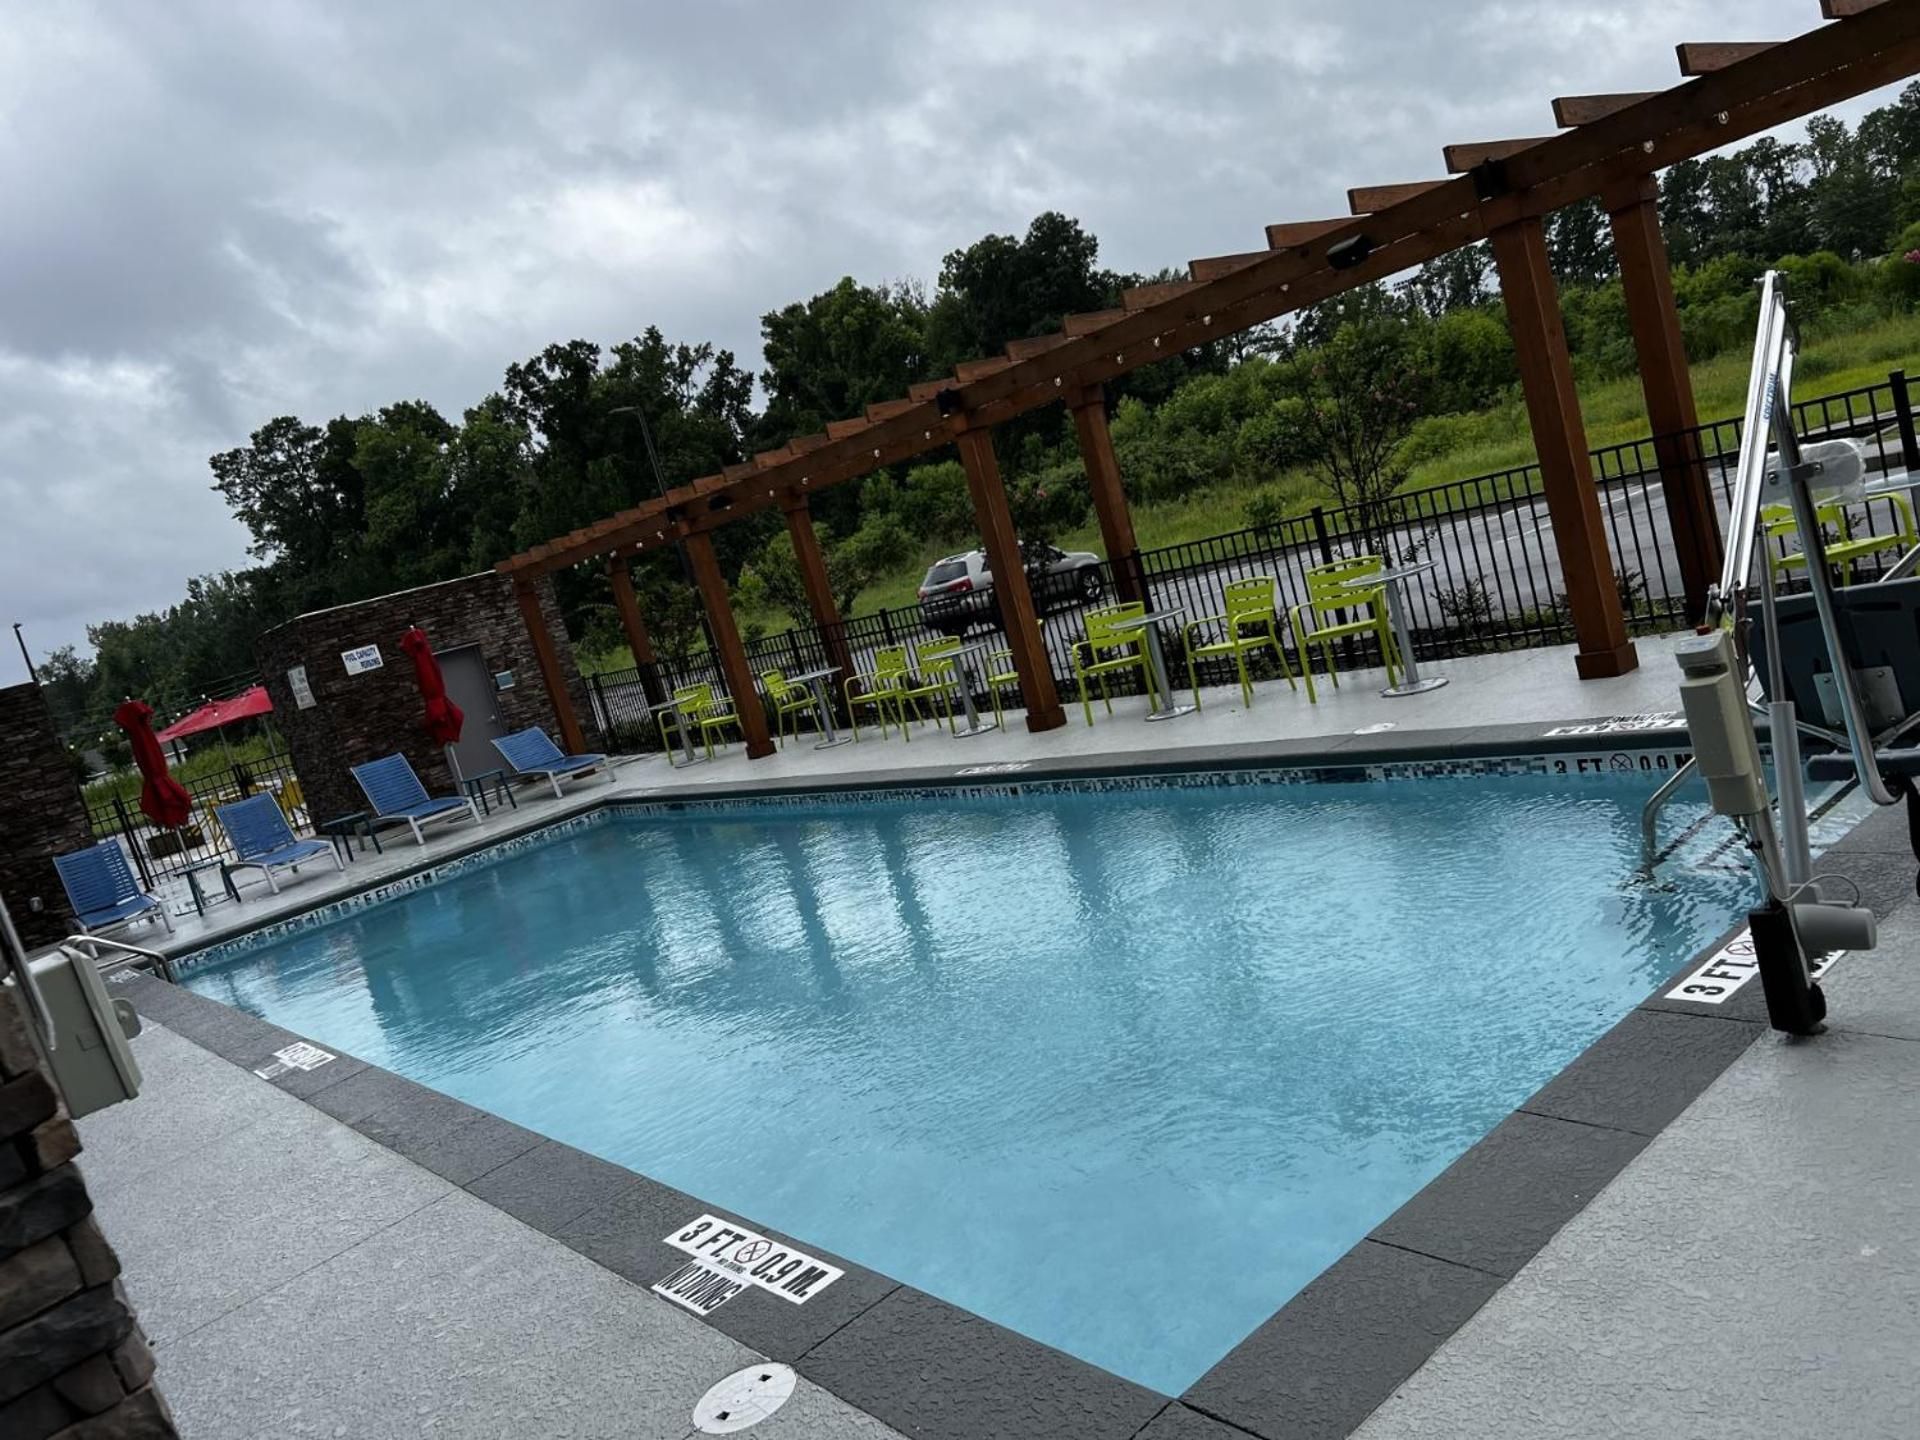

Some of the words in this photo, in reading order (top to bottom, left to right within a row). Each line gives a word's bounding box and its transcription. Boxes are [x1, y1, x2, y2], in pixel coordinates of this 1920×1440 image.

[1554, 760, 1568, 774] 3
[1576, 758, 1603, 773] FT
[1683, 984, 1725, 996] 3
[679, 1222, 712, 1243] 3
[696, 1228, 747, 1257] FT.
[750, 1252, 803, 1284] 0.9
[780, 1265, 829, 1297] M.
[657, 1261, 702, 1290] NO
[672, 1267, 743, 1311] DIVING
